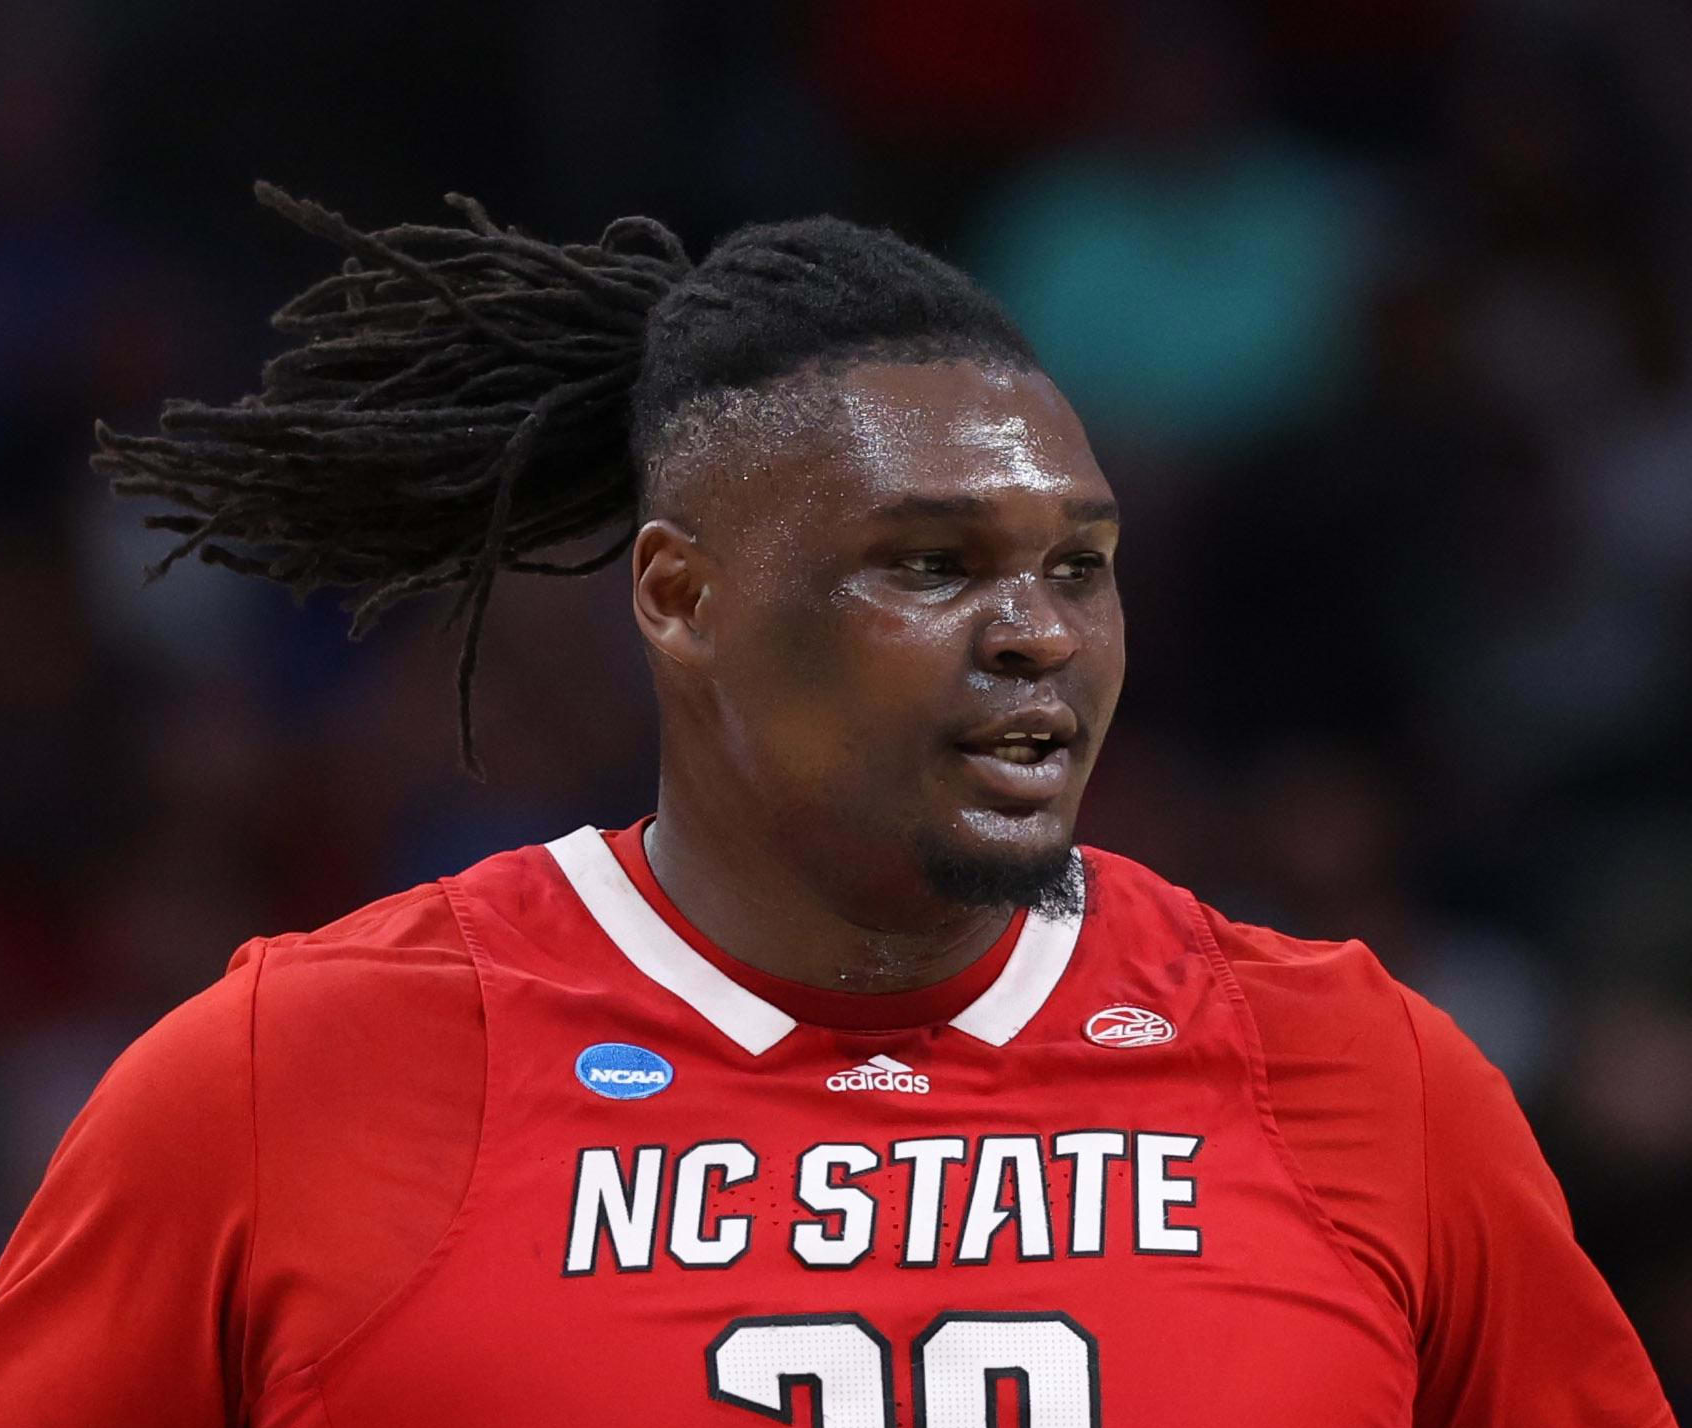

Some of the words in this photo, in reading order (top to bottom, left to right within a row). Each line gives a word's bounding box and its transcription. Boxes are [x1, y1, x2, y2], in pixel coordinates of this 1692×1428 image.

[1091, 1020, 1167, 1039] ACC
[589, 1067, 666, 1085] NCAA
[826, 1070, 930, 1095] adidas
[562, 1139, 758, 1277] NC
[788, 1128, 1204, 1269] STATE
